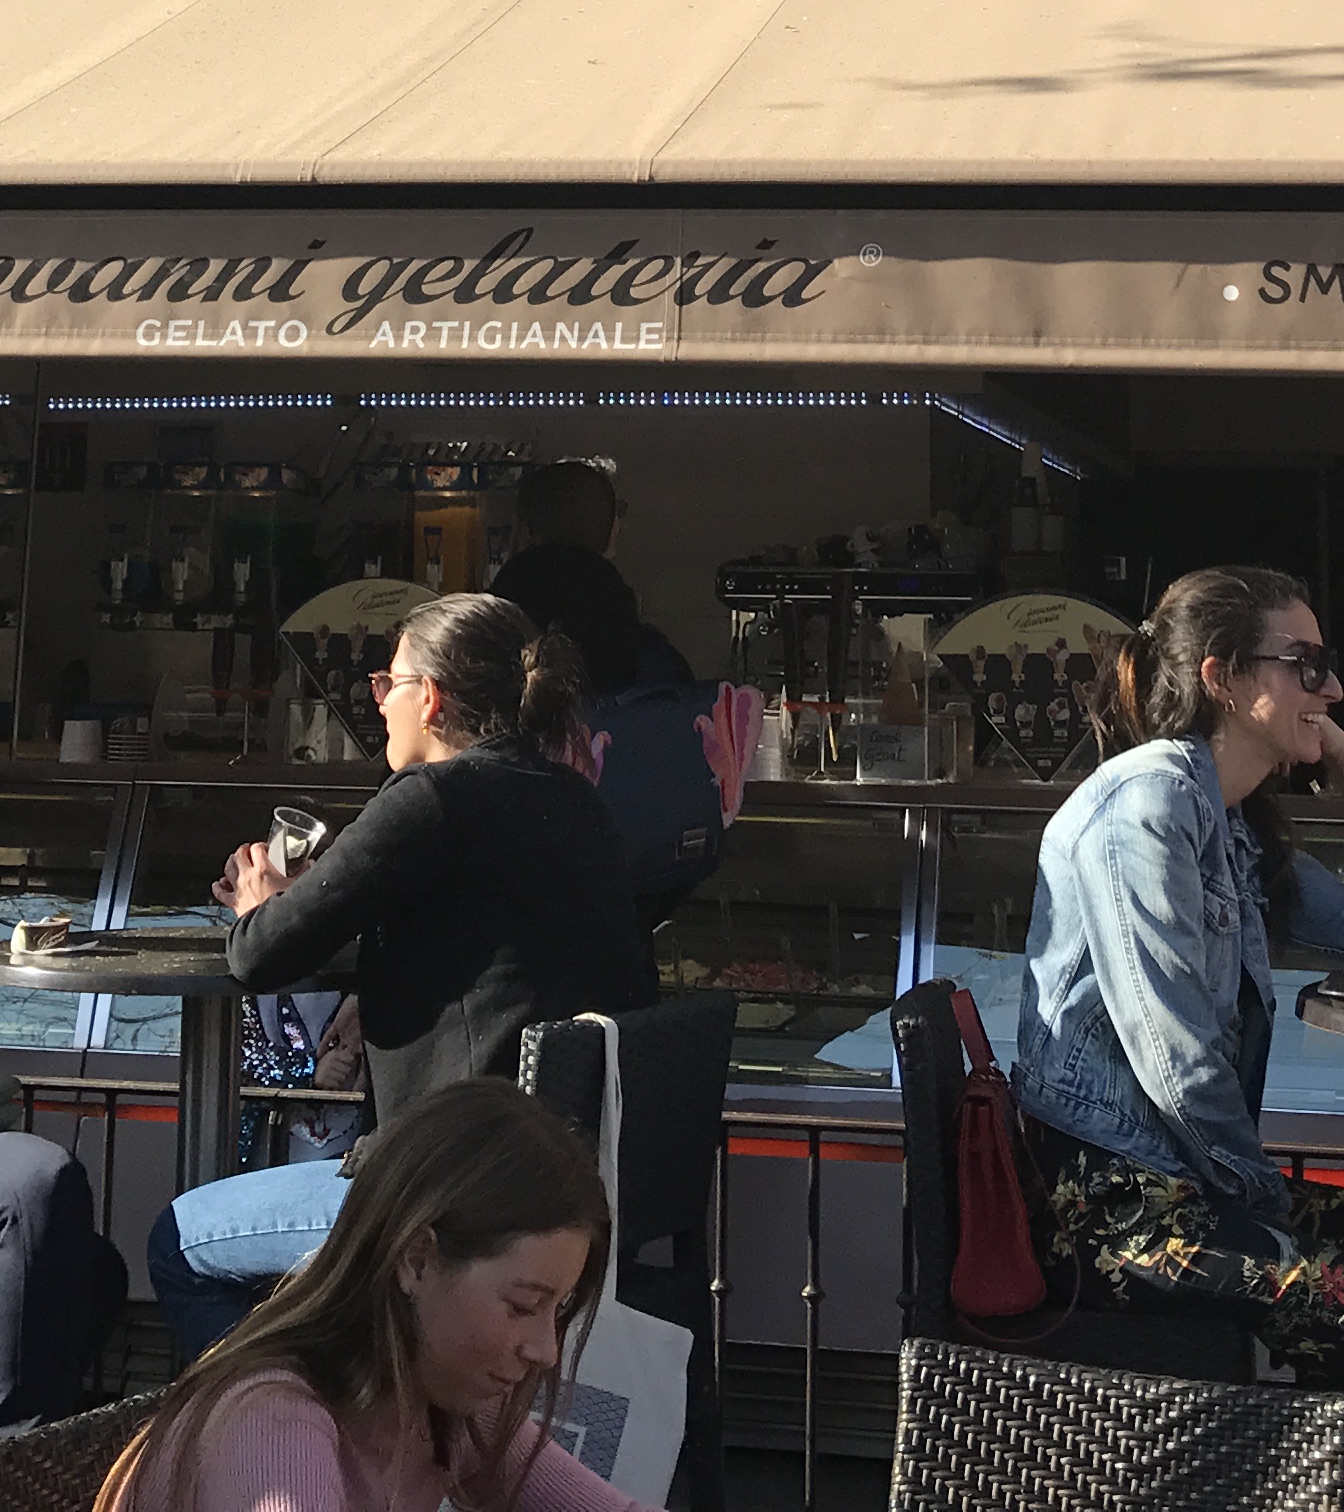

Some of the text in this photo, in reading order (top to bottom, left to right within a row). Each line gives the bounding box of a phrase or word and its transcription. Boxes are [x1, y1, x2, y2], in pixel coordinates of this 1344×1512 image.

[325, 226, 836, 337] gelateria
[136, 318, 665, 350] GELATO ARTIGIANALE
